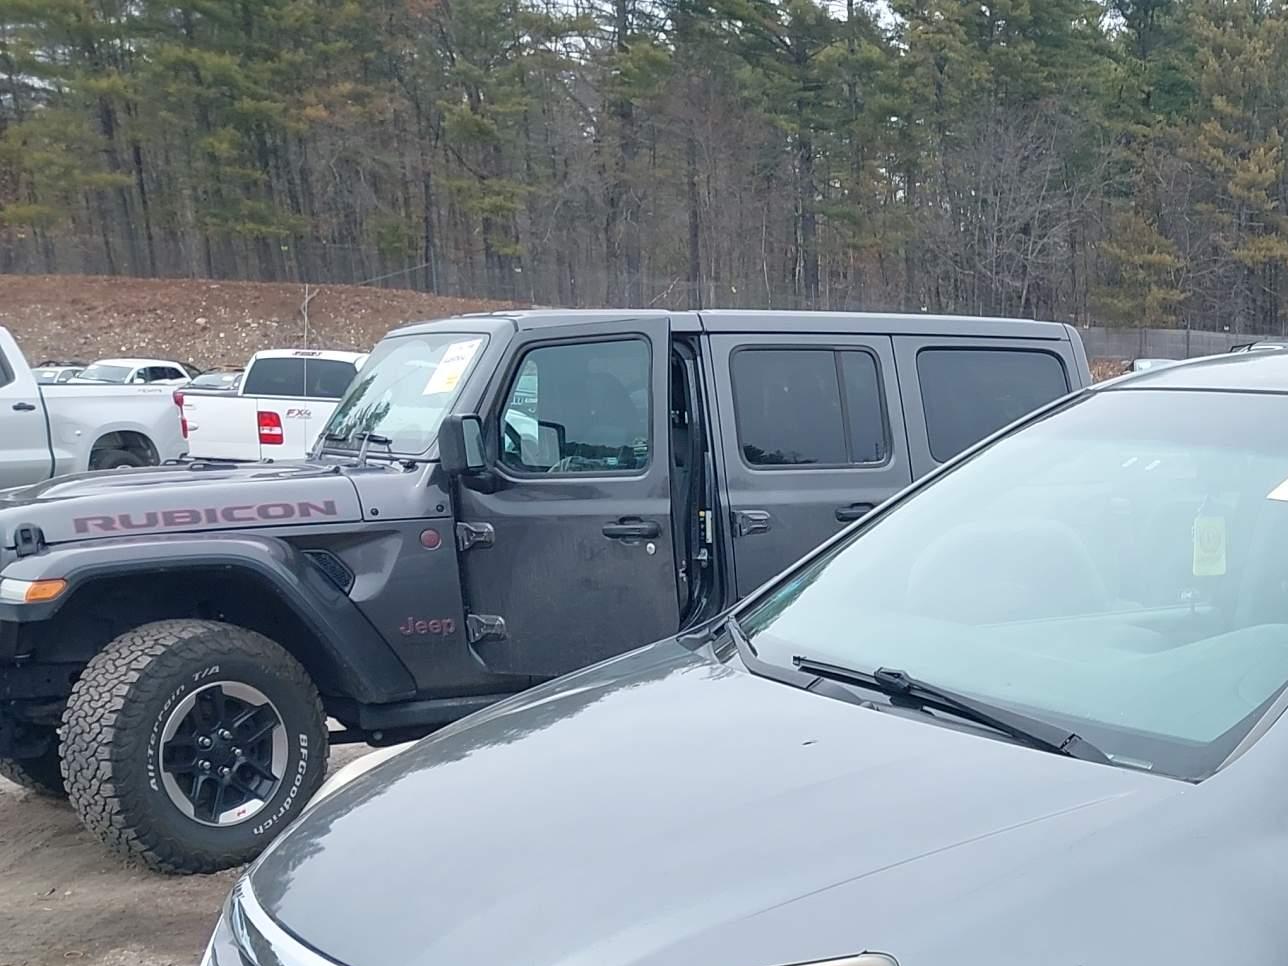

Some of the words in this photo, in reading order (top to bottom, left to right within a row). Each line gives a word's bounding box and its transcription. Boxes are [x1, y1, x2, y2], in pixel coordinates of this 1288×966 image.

[286, 408, 312, 417] FX4
[73, 499, 338, 534] RUBICON
[399, 616, 456, 636] Jeep
[146, 684, 186, 792] All-Terrain
[191, 664, 221, 682] T/A
[253, 733, 309, 836] BFGoodrich
